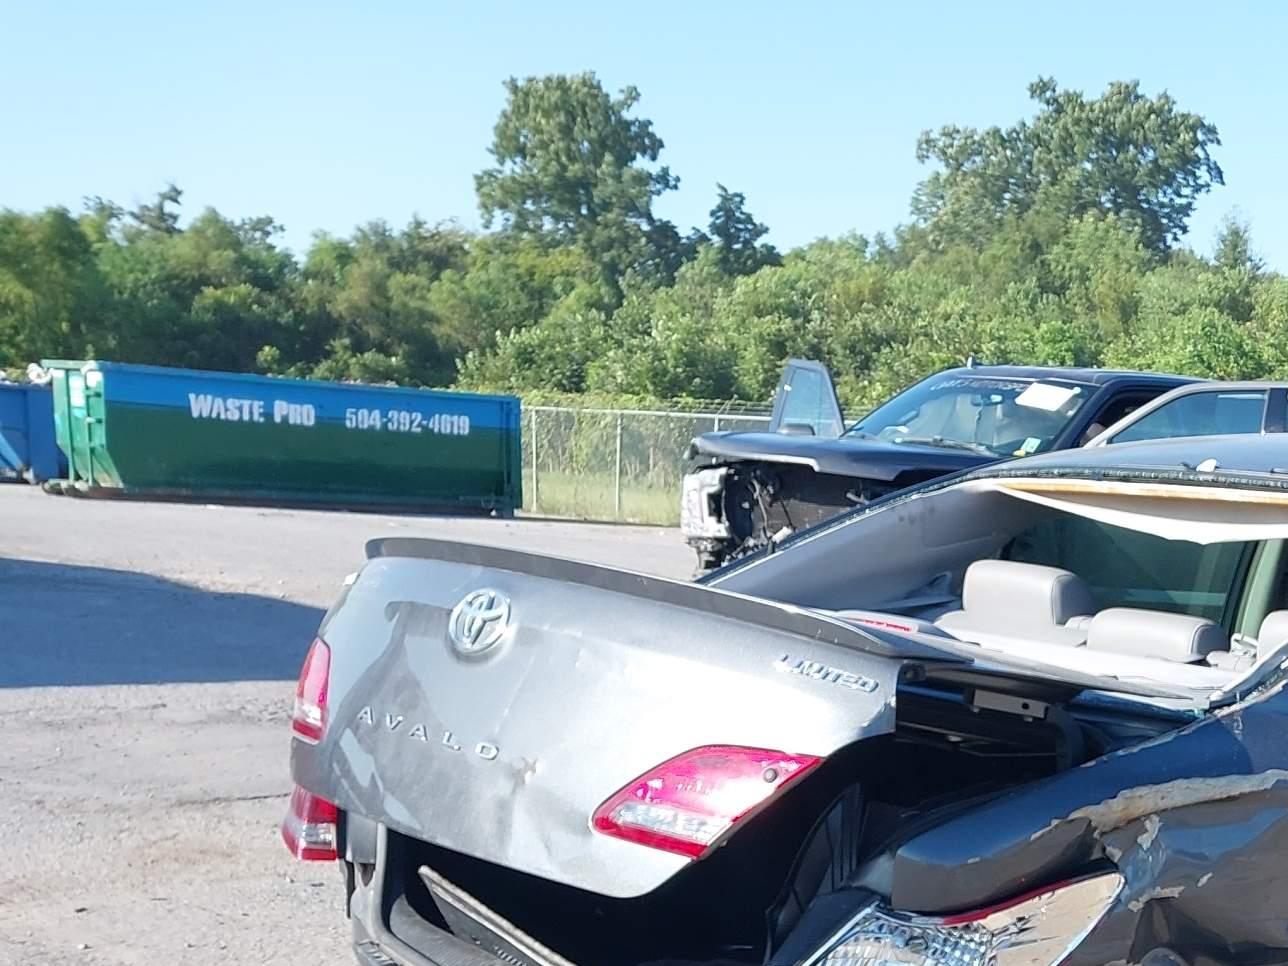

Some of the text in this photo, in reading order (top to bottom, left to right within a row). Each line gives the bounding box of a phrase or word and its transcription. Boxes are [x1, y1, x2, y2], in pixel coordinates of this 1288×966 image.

[188, 392, 265, 423] WASTE
[273, 399, 316, 427] PRO
[775, 653, 880, 693] LIMITED
[356, 705, 500, 761] AVALO
